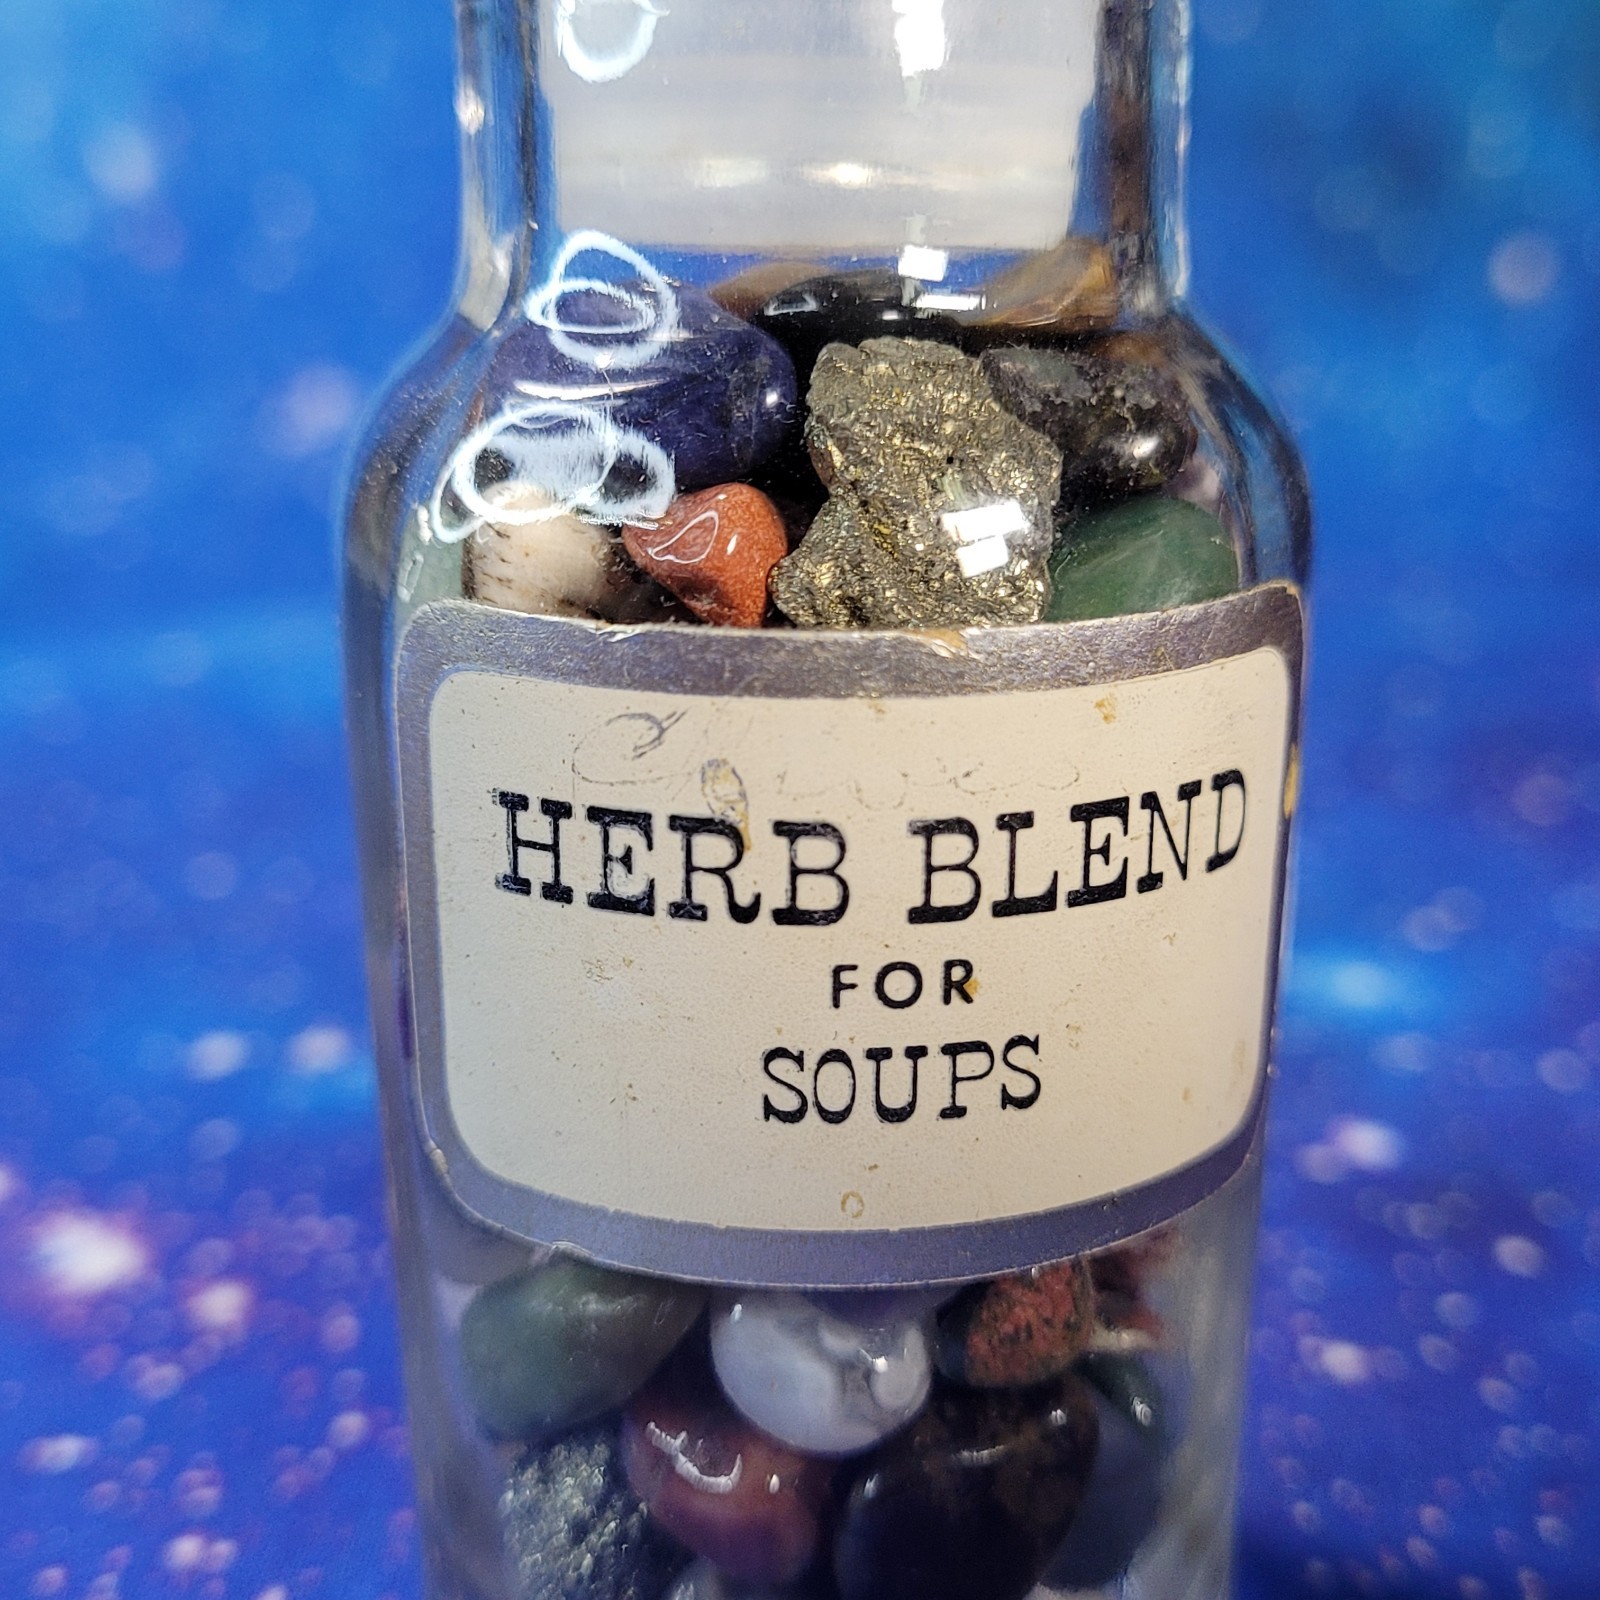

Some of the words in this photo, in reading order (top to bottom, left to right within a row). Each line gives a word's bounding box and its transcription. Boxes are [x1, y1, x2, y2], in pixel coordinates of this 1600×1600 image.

[494, 789, 850, 927] HERB
[907, 767, 1248, 925] BLEND
[831, 959, 975, 1010] FOR
[763, 1034, 1042, 1126] SOUPS
